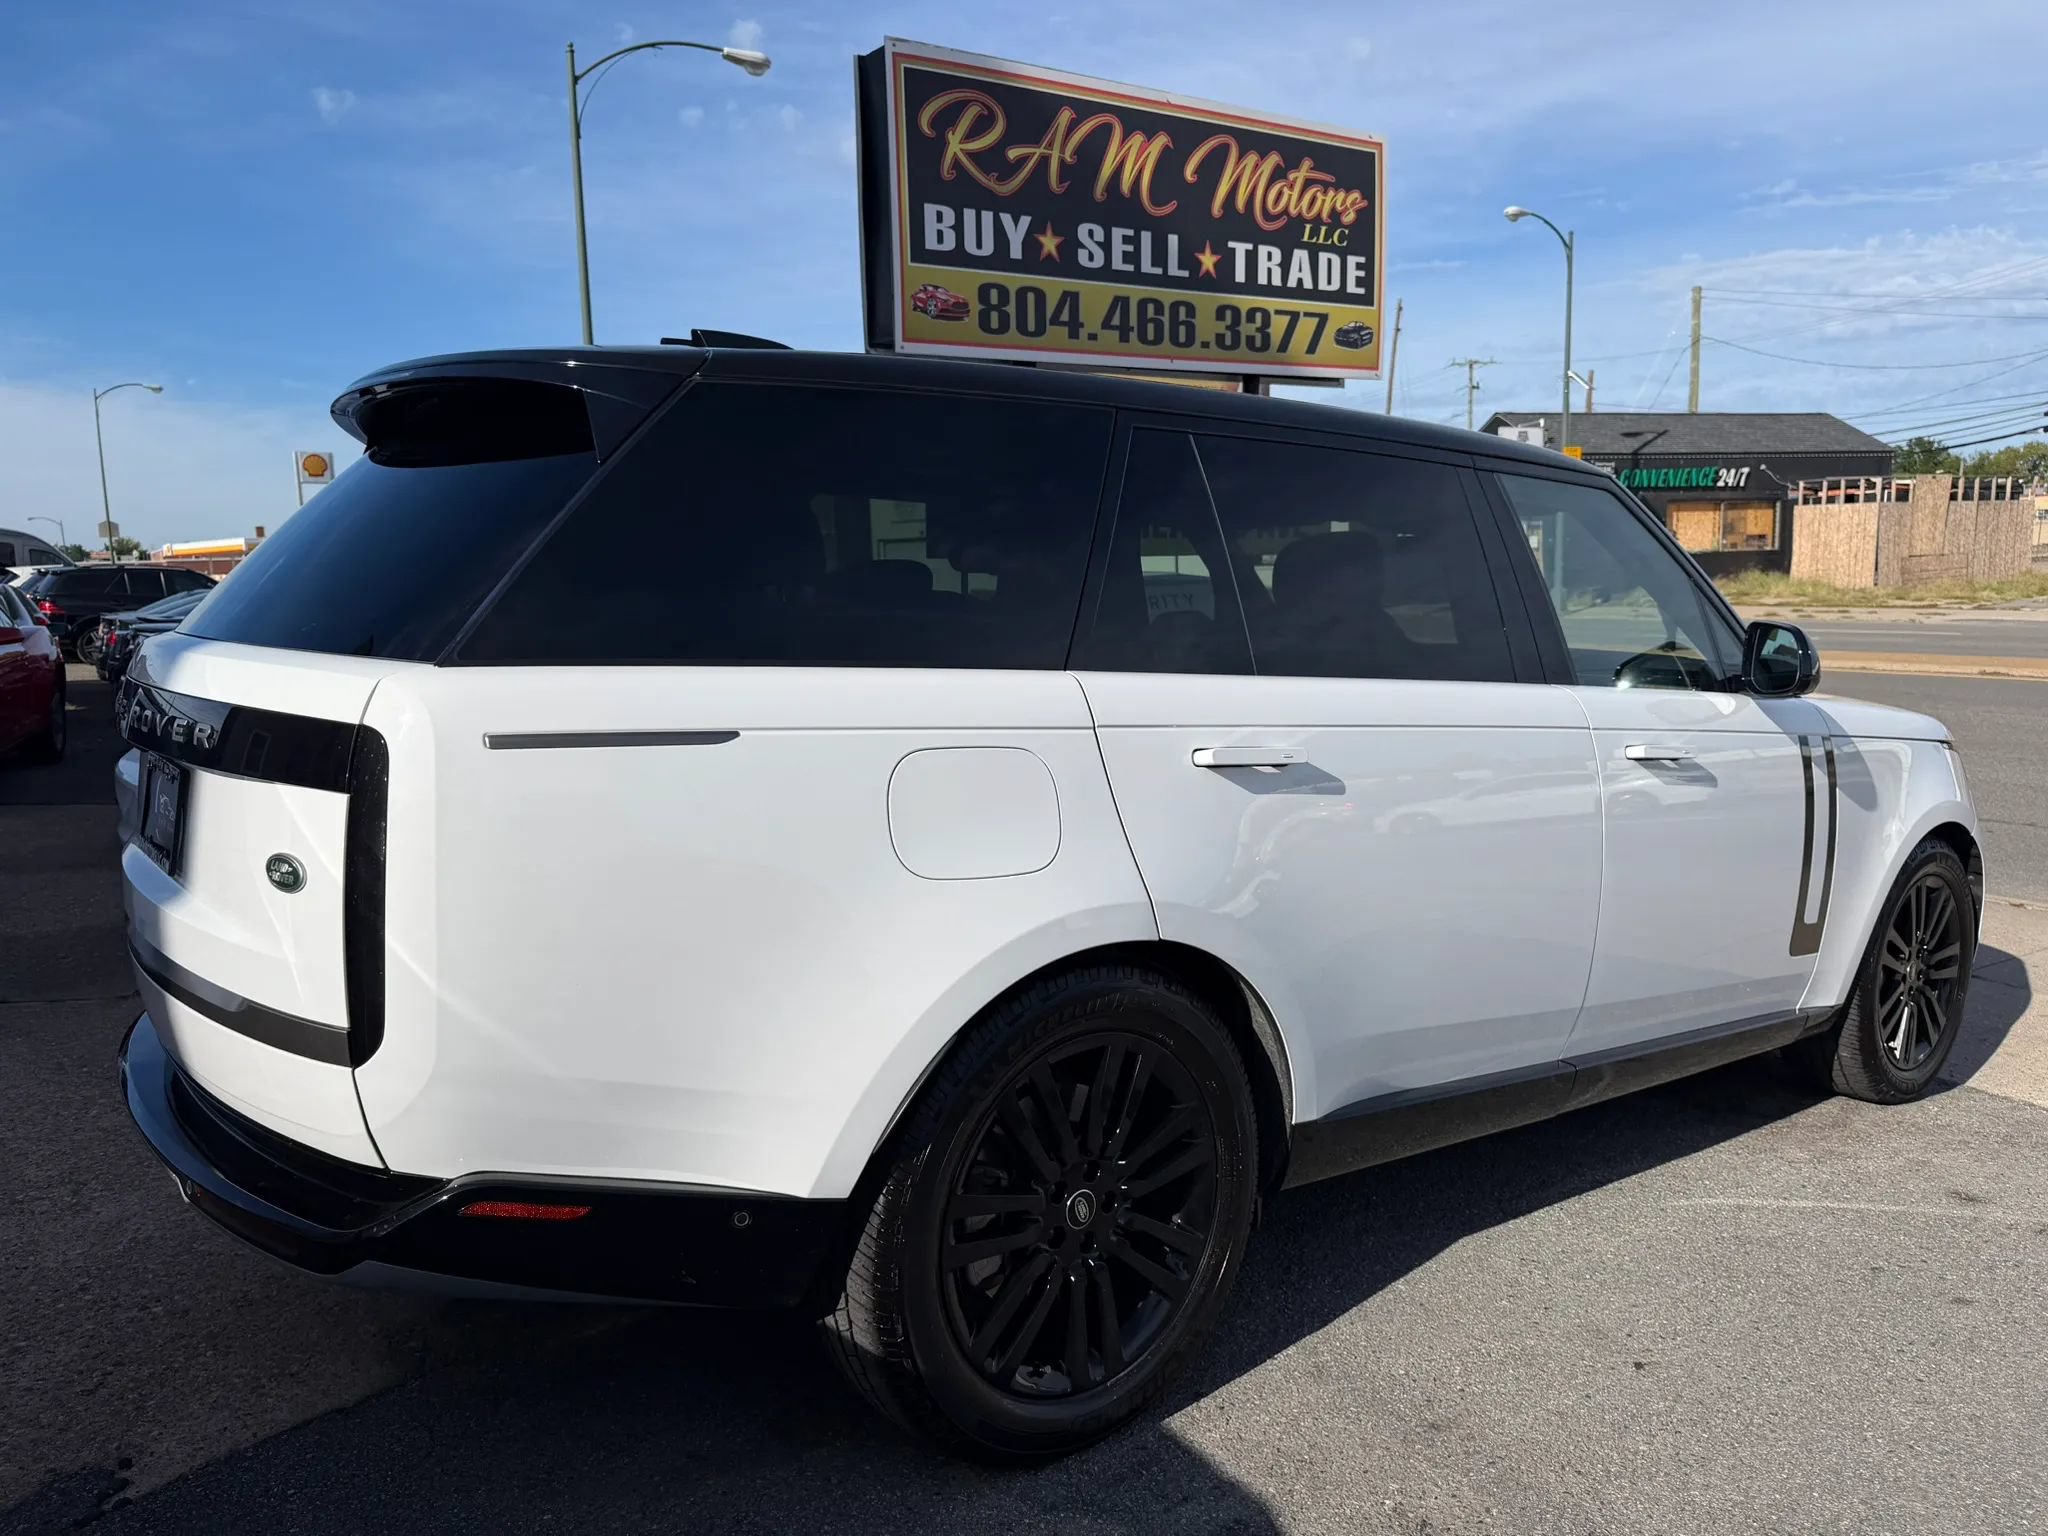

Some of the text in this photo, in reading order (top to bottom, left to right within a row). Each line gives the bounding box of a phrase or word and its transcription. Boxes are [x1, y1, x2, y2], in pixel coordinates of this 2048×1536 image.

[918, 88, 1369, 232] RAM Motors
[923, 203, 1367, 295] BUY SELL TRADE
[1301, 222, 1350, 248] LLC
[977, 281, 1329, 356] 804.466.3377
[1620, 465, 1717, 487] CONVENIENCE
[1716, 466, 1750, 487] 24/7
[131, 705, 210, 748] ROVER
